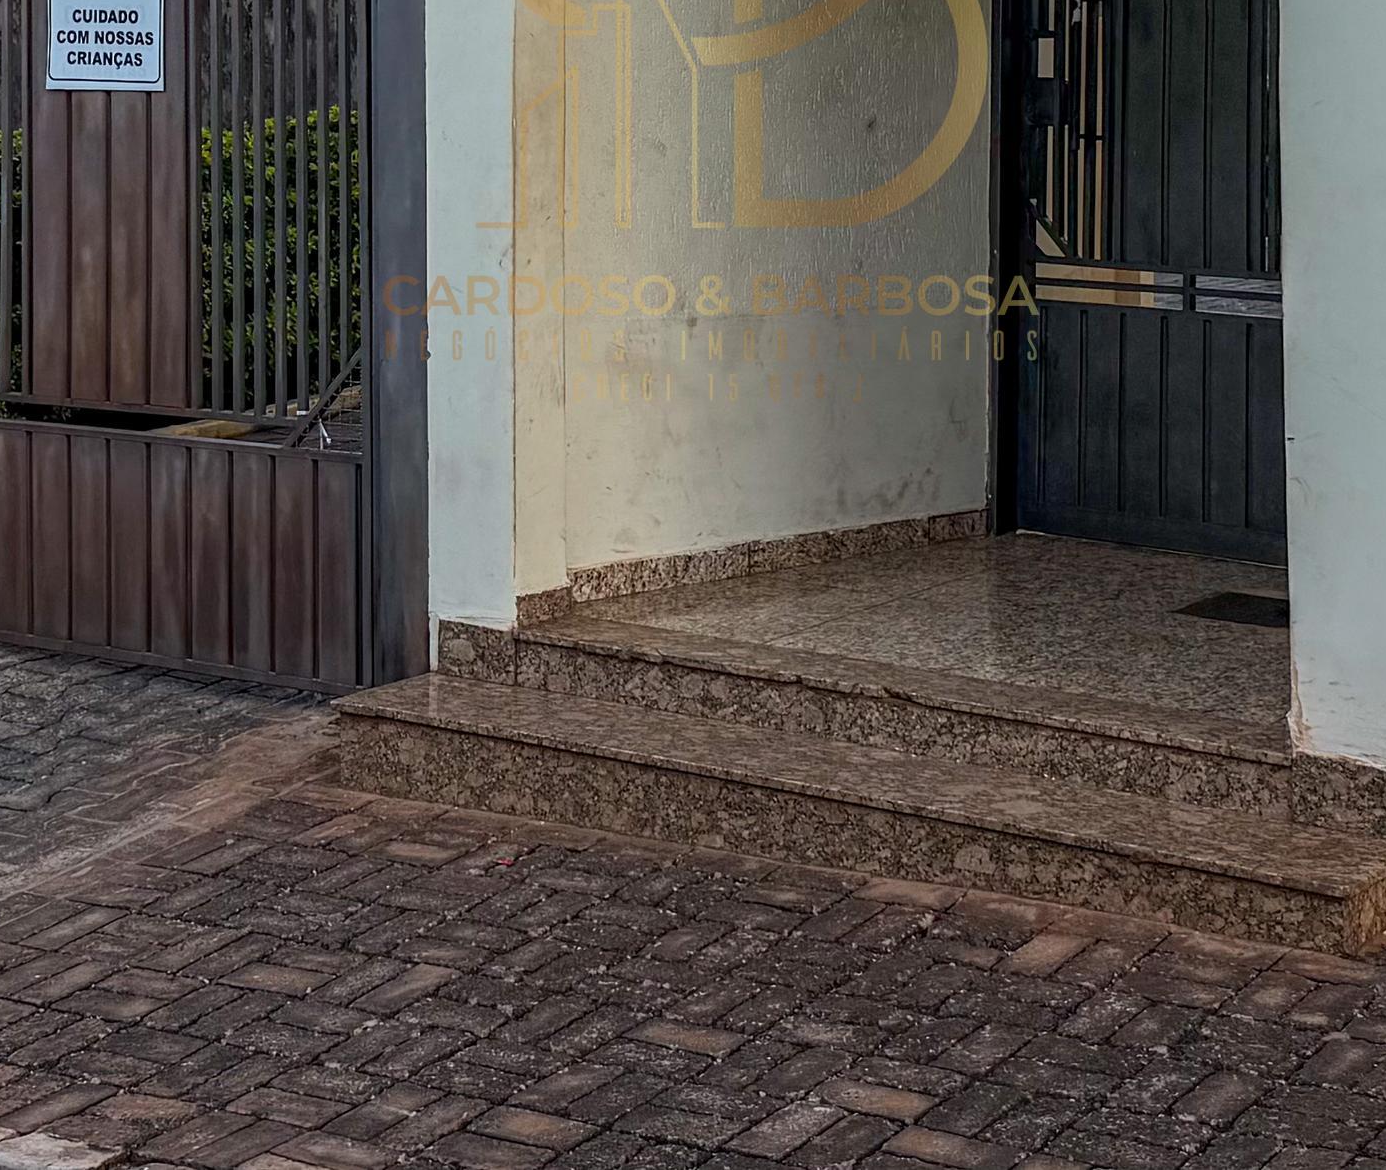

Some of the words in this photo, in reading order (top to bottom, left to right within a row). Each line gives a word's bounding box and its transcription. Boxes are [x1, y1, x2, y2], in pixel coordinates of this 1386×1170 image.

[72, 9, 139, 24] CUIDADO
[56, 30, 89, 44] COM
[95, 31, 154, 46] NOSSAS
[67, 51, 143, 70] CRIANÇAS
